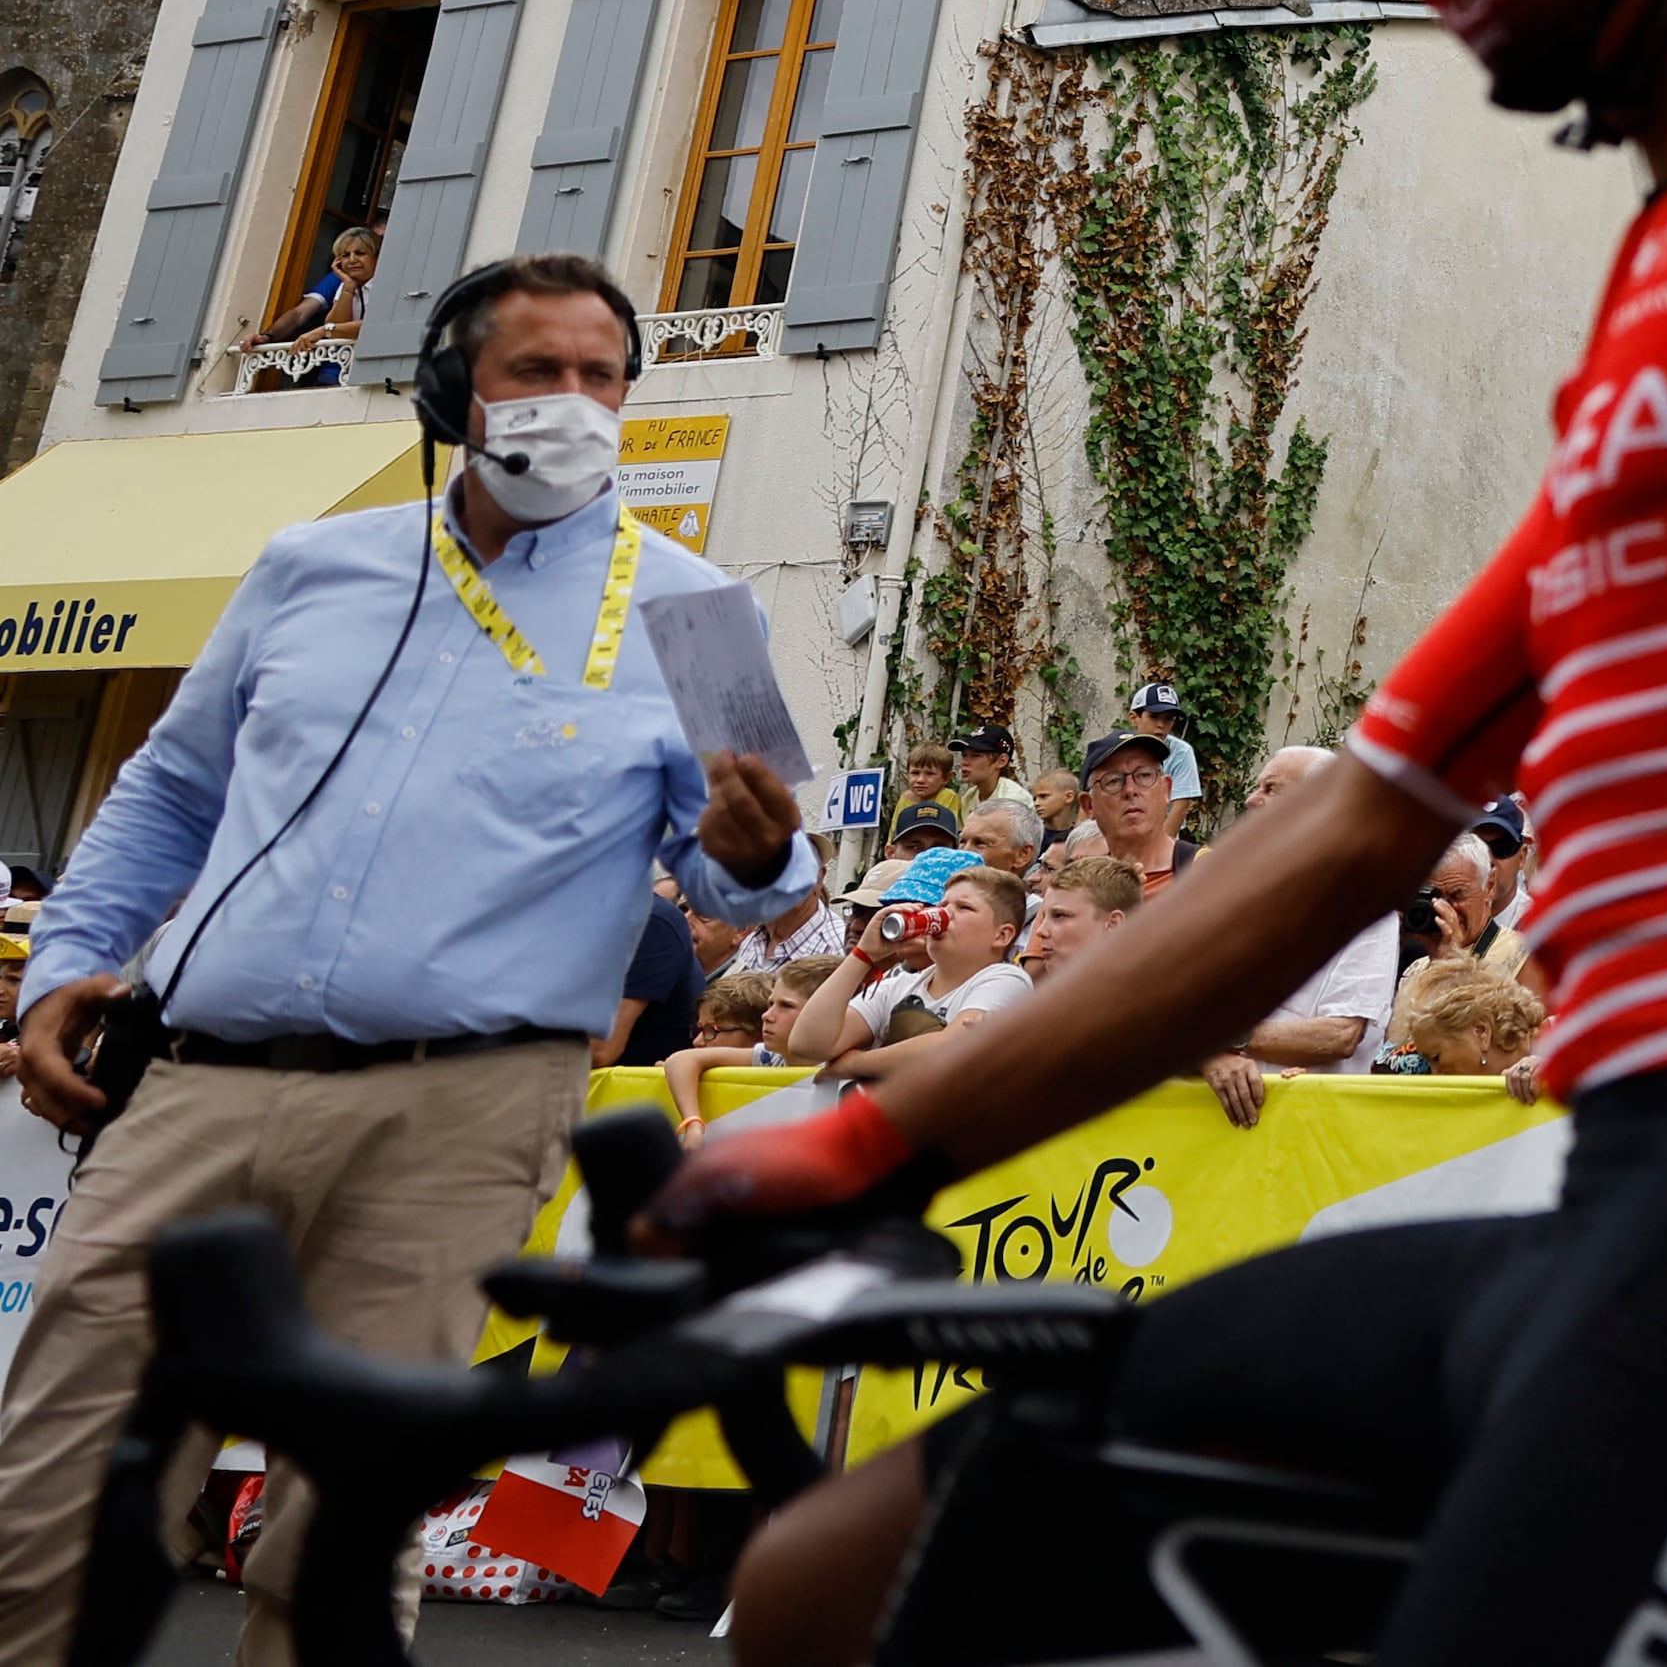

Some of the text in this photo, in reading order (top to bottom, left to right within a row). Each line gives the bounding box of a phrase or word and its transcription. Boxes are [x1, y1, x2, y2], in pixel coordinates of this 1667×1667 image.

[647, 420, 669, 433] AU
[664, 428, 723, 450] FRANCE
[617, 468, 685, 482] la maison
[618, 482, 701, 498] l'immobilier
[849, 784, 875, 814] WC
[942, 1156, 1156, 1289] TOUR
[1072, 1245, 1108, 1286] de
